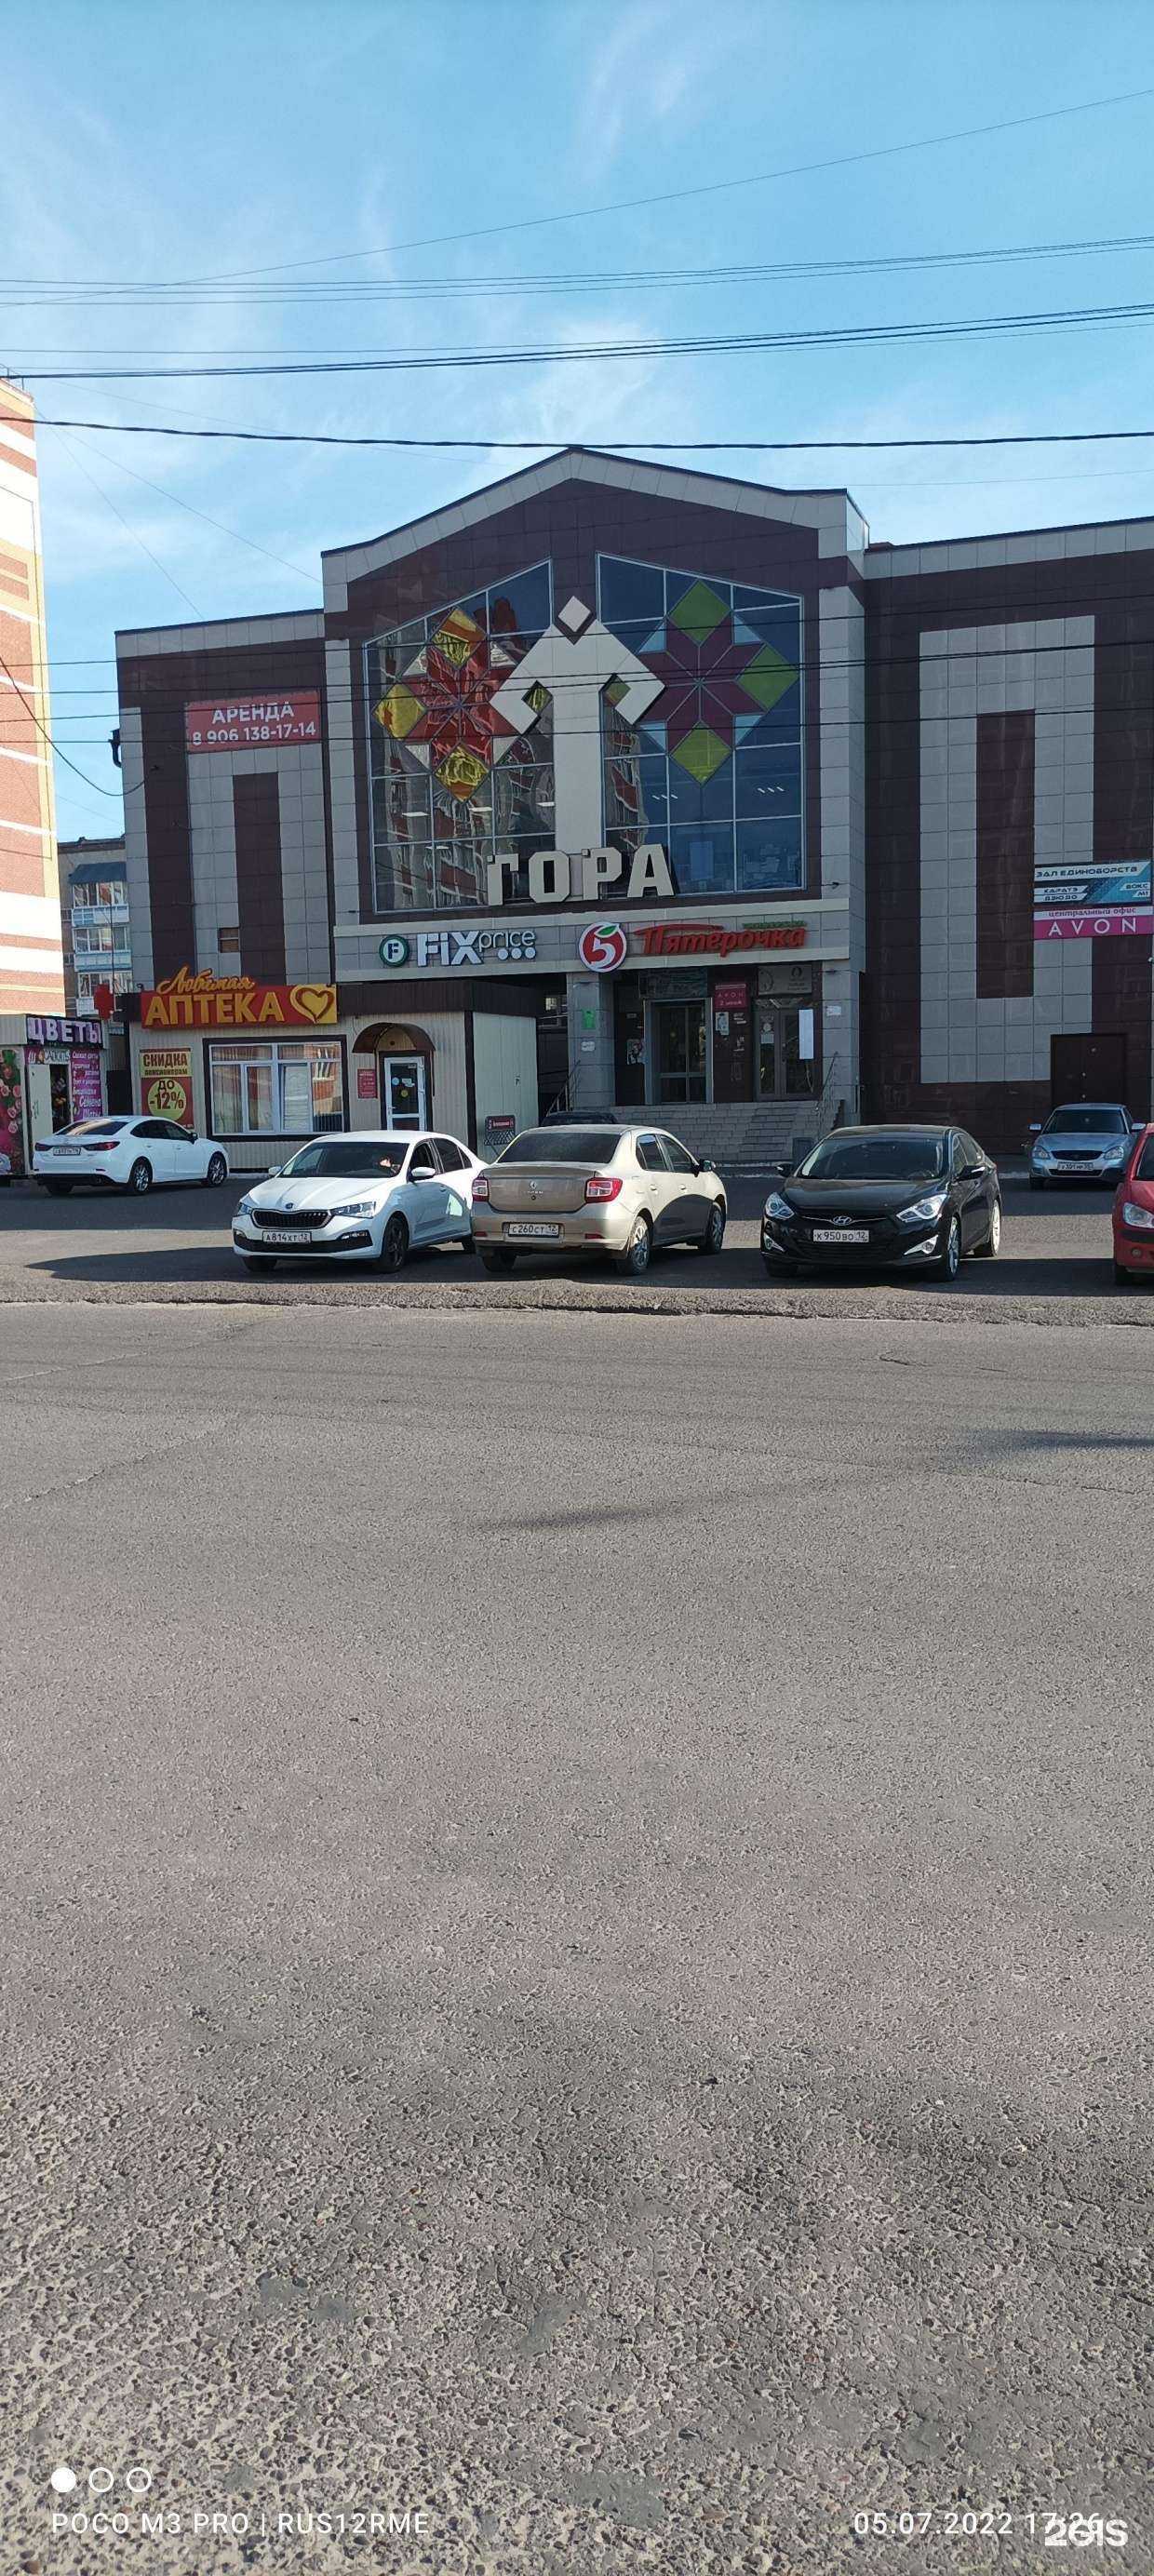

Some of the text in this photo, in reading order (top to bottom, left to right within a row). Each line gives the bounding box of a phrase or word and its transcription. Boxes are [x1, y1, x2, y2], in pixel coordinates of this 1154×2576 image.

[212, 701, 294, 724] АРЕНДА
[193, 721, 316, 745] 8 906 138-17-14
[487, 844, 675, 906] ГОРА
[1048, 917, 1136, 937] AVON
[478, 931, 536, 953] price
[145, 992, 285, 1026] АПТЕКА
[27, 1017, 101, 1045] ЦВЕТЫ
[142, 1053, 188, 1067] СКИДКА
[158, 1080, 175, 1092] ДО
[149, 1091, 184, 1110] -12%
